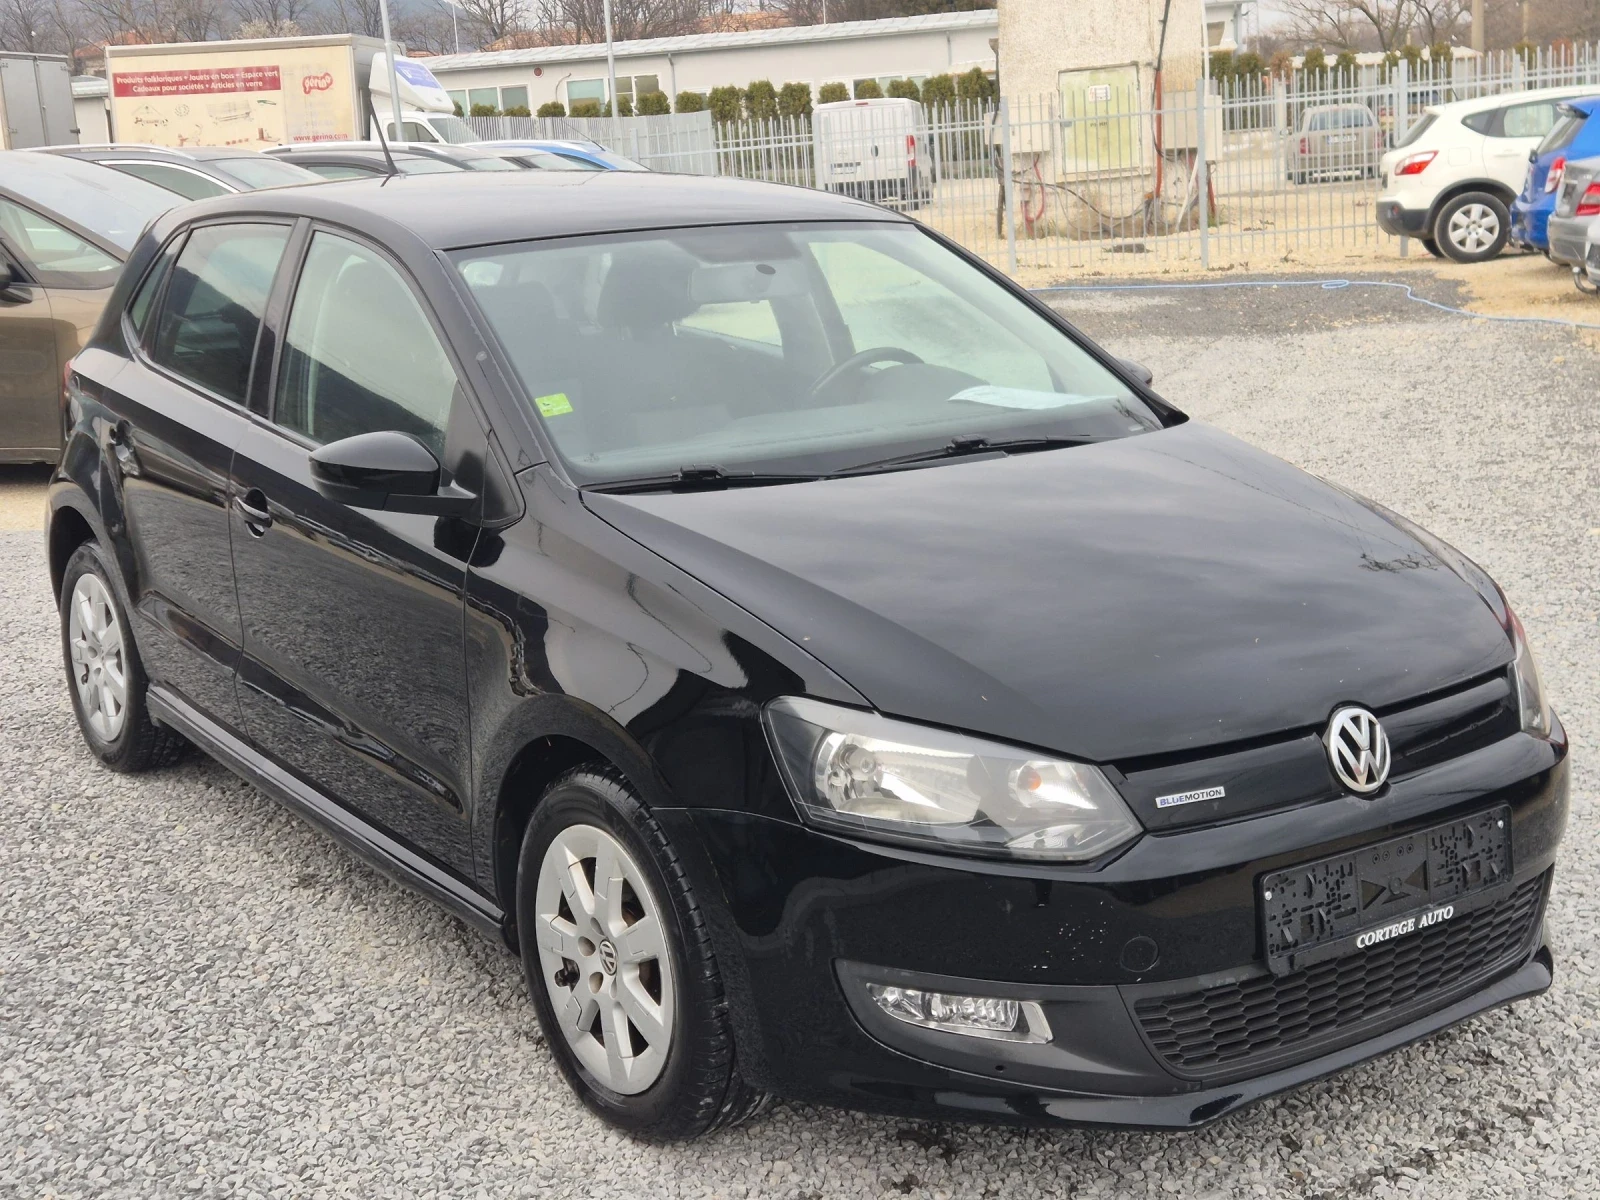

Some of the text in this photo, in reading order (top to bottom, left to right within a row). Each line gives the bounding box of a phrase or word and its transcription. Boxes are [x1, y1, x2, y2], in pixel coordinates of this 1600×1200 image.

[116, 76, 143, 84] Produits
[145, 75, 182, 83] folkloriques
[241, 71, 263, 79] Espace
[132, 85, 160, 93] Cadeaux
[162, 84, 177, 93] pour
[178, 82, 204, 91] sociétés
[293, 133, 348, 142] www.gerino.com
[1159, 788, 1222, 806] BLUEMOTION
[1356, 905, 1454, 949] CORTEGE AUTO
